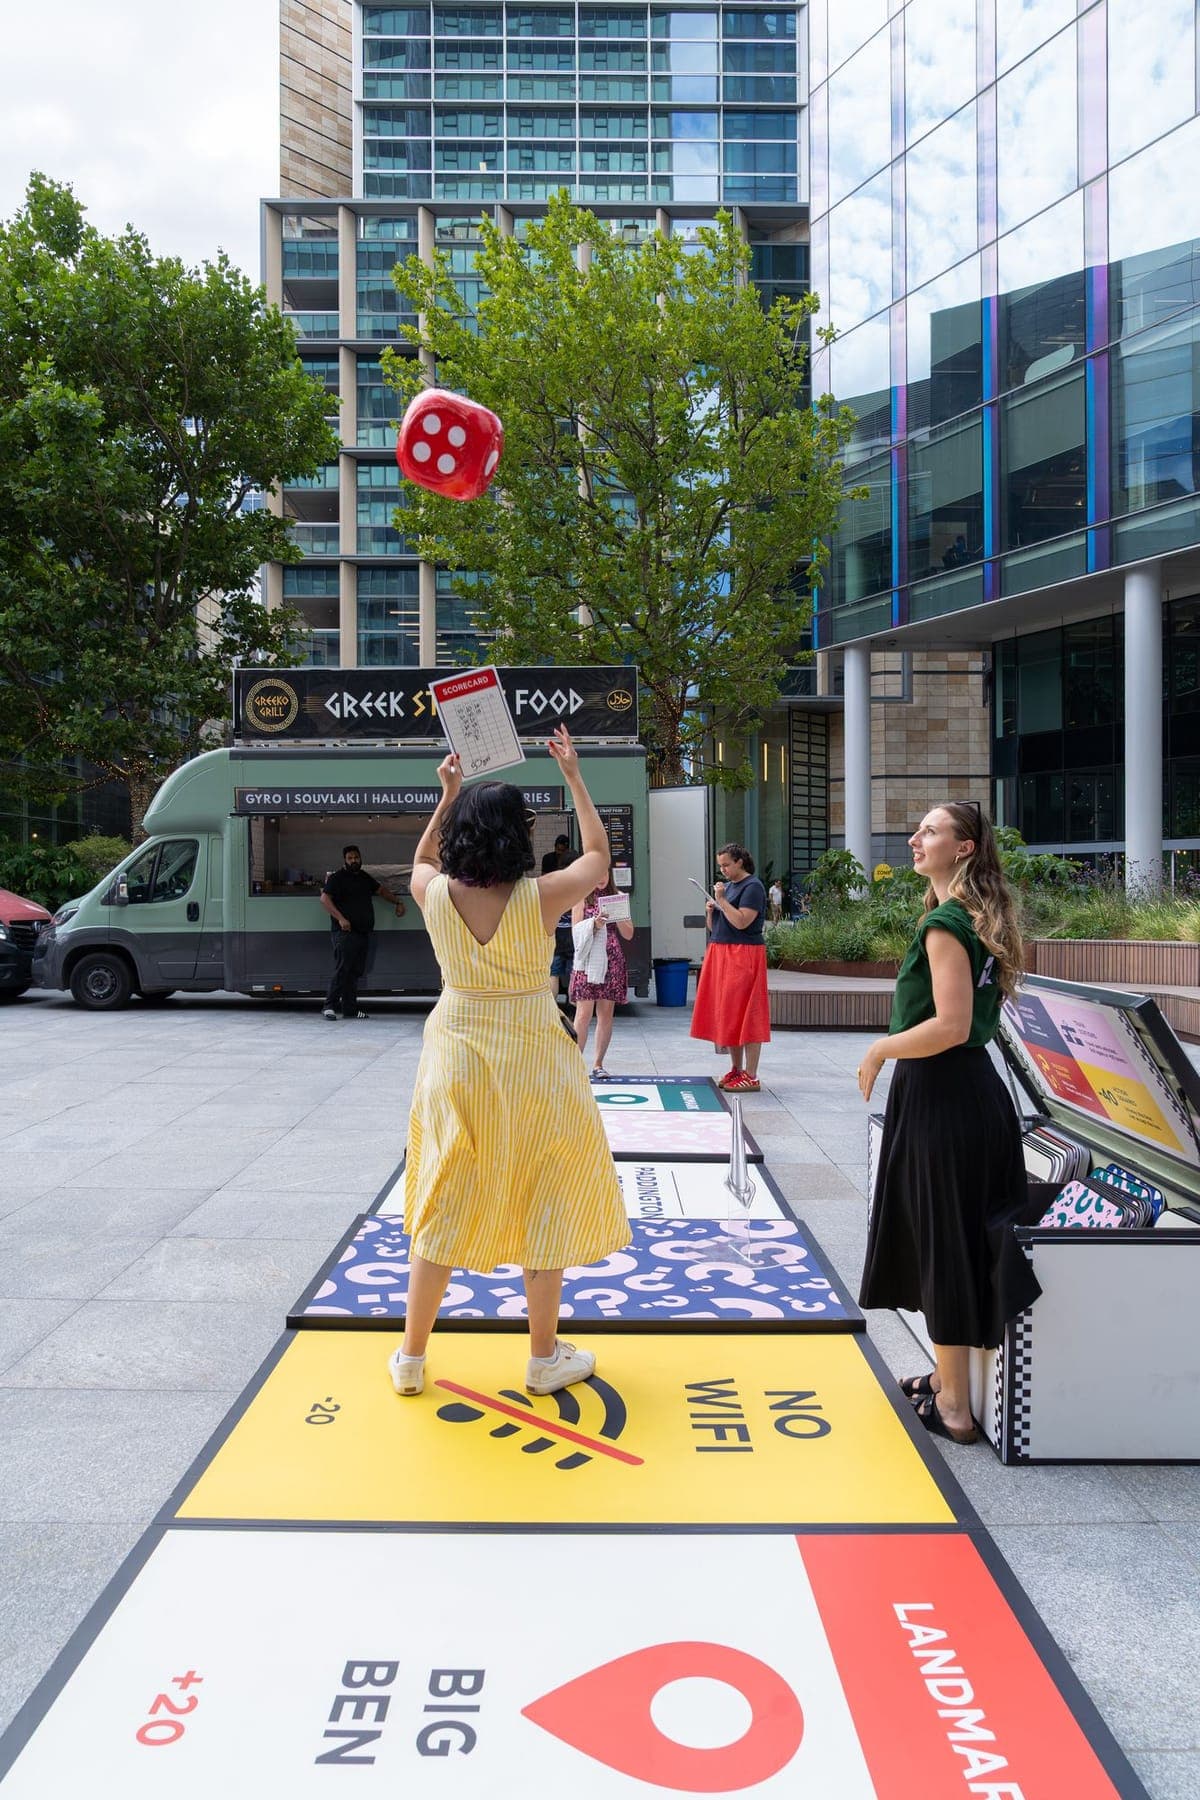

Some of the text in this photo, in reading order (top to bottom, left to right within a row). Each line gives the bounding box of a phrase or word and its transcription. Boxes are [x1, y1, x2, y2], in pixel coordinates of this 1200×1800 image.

[254, 696, 289, 706] GREEKO
[324, 691, 404, 719] GREEK
[515, 688, 584, 716] FOOD
[442, 675, 489, 696] SCORECARD
[259, 706, 285, 717] GRILL
[245, 792, 551, 804] GYRO SOUVLAKI HALLOUMI RIES
[634, 1166, 665, 1220] PADDINGTON
[304, 1396, 341, 1425] -20
[684, 1377, 754, 1453] WIFI
[763, 1390, 832, 1440] NO
[135, 1669, 204, 1746] +20
[314, 1659, 400, 1765] BEN
[416, 1668, 486, 1757] BIG
